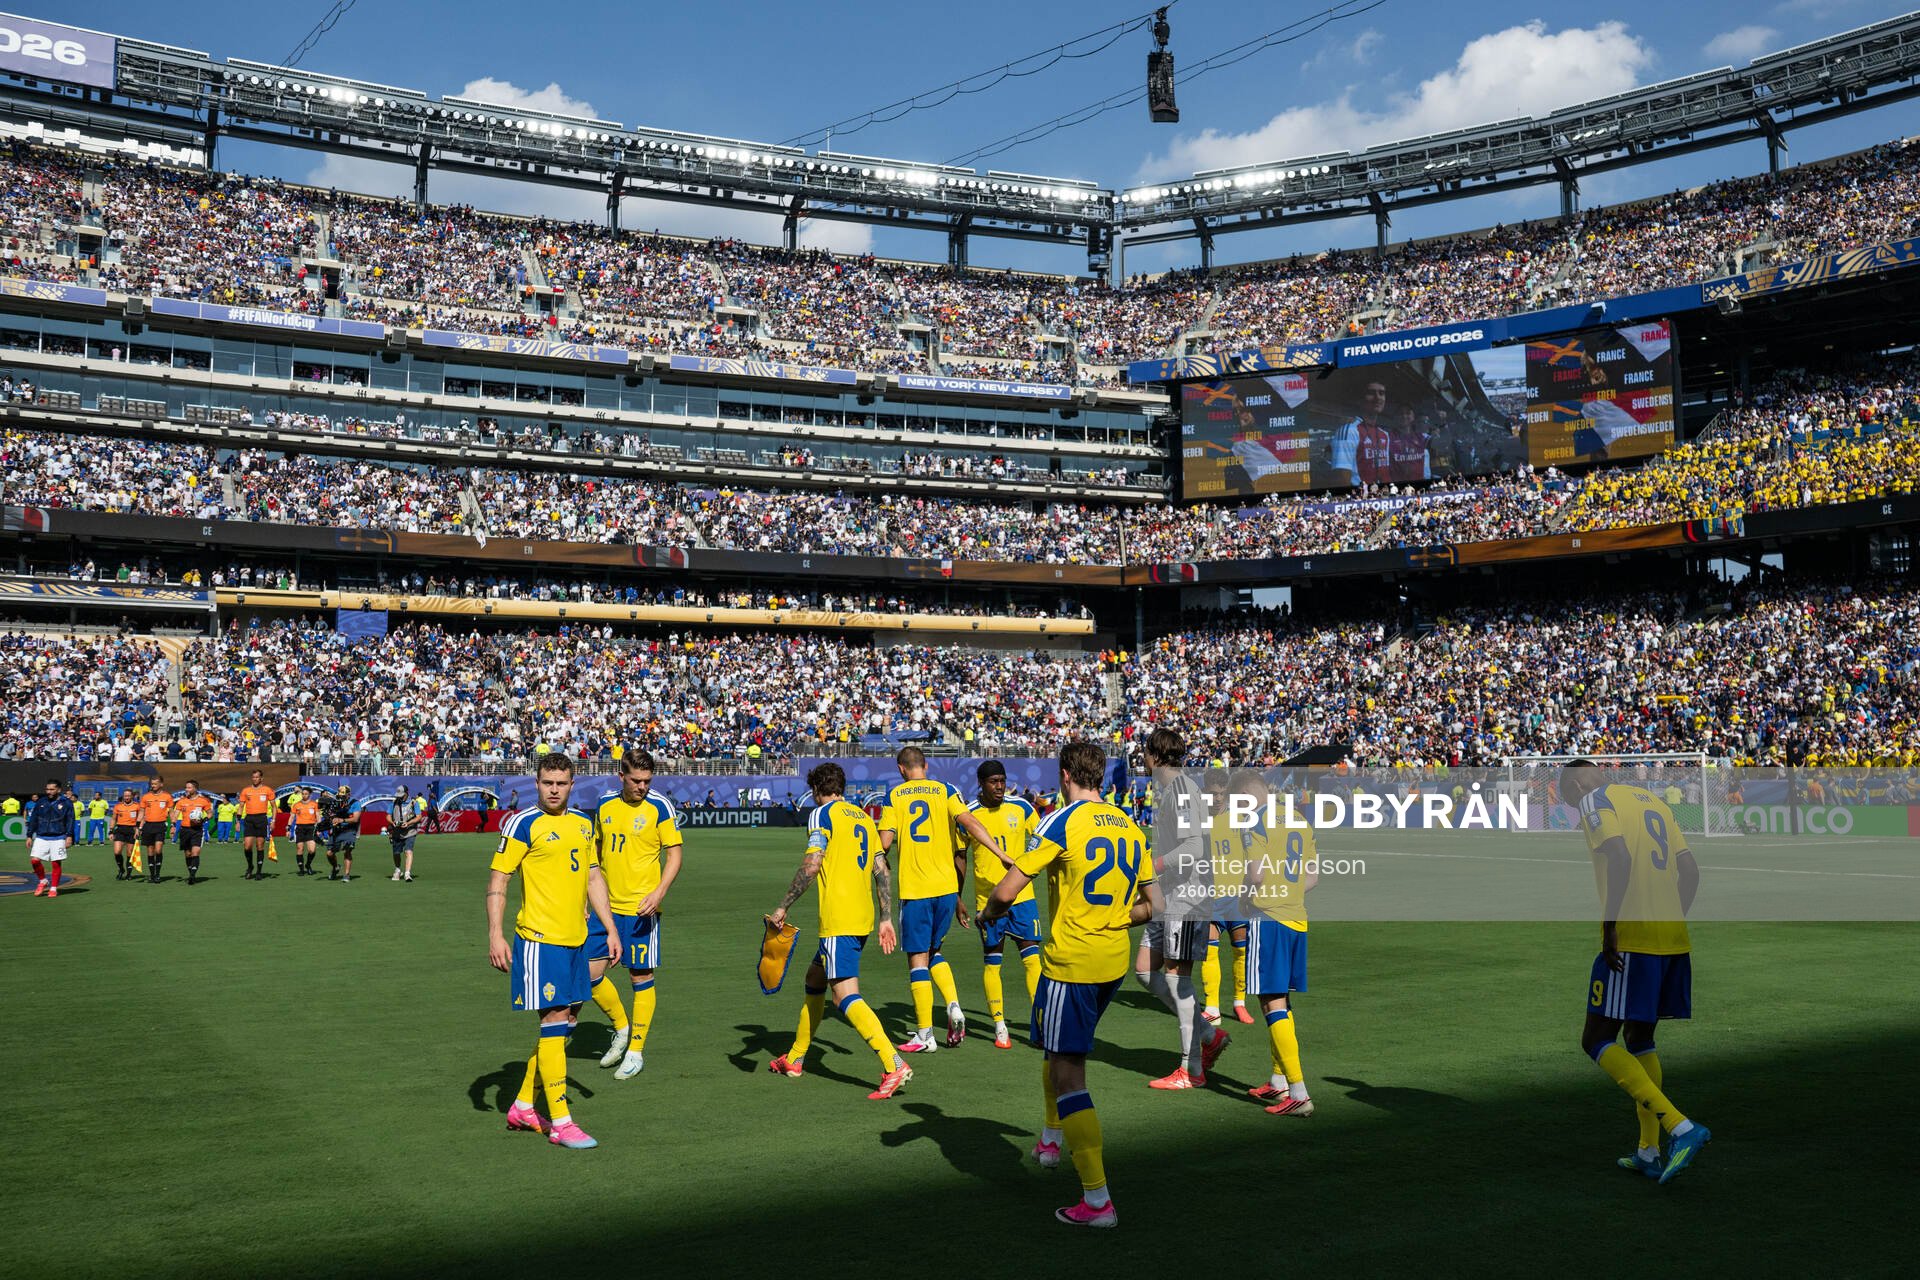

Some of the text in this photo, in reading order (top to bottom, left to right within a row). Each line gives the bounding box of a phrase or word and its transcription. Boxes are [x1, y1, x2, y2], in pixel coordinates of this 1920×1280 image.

[228, 308, 316, 329] #FIFAWorldCup
[1343, 329, 1484, 358] FIFA WORLD CUP 2026
[1597, 348, 1626, 362] FRANCE
[1624, 370, 1654, 384] FRANCE
[906, 378, 1063, 396] NEW YORK NEW JERSEY
[1245, 395, 1271, 406] FRANCE
[1269, 416, 1295, 427] FRANCE
[1564, 418, 1596, 433] SWEDEN
[1544, 446, 1575, 460] SWEDEN
[1216, 456, 1245, 467] SWEDEN
[1198, 480, 1226, 491] SWEDEN
[1882, 504, 1892, 515] CE
[202, 526, 213, 536] CE
[523, 545, 533, 555] EN
[896, 786, 941, 797] LAGERBIELKE
[692, 810, 768, 825] HYUNDAI
[909, 799, 931, 843] 2
[1093, 813, 1129, 829] STROUD
[611, 833, 626, 853] 17
[853, 823, 869, 871] 3
[1643, 809, 1669, 870] 9
[1214, 839, 1231, 857] 18
[570, 848, 579, 872] 5
[1283, 831, 1304, 883] 8
[1082, 836, 1142, 906] 24
[630, 944, 648, 965] 17
[1591, 980, 1604, 1006] 9
